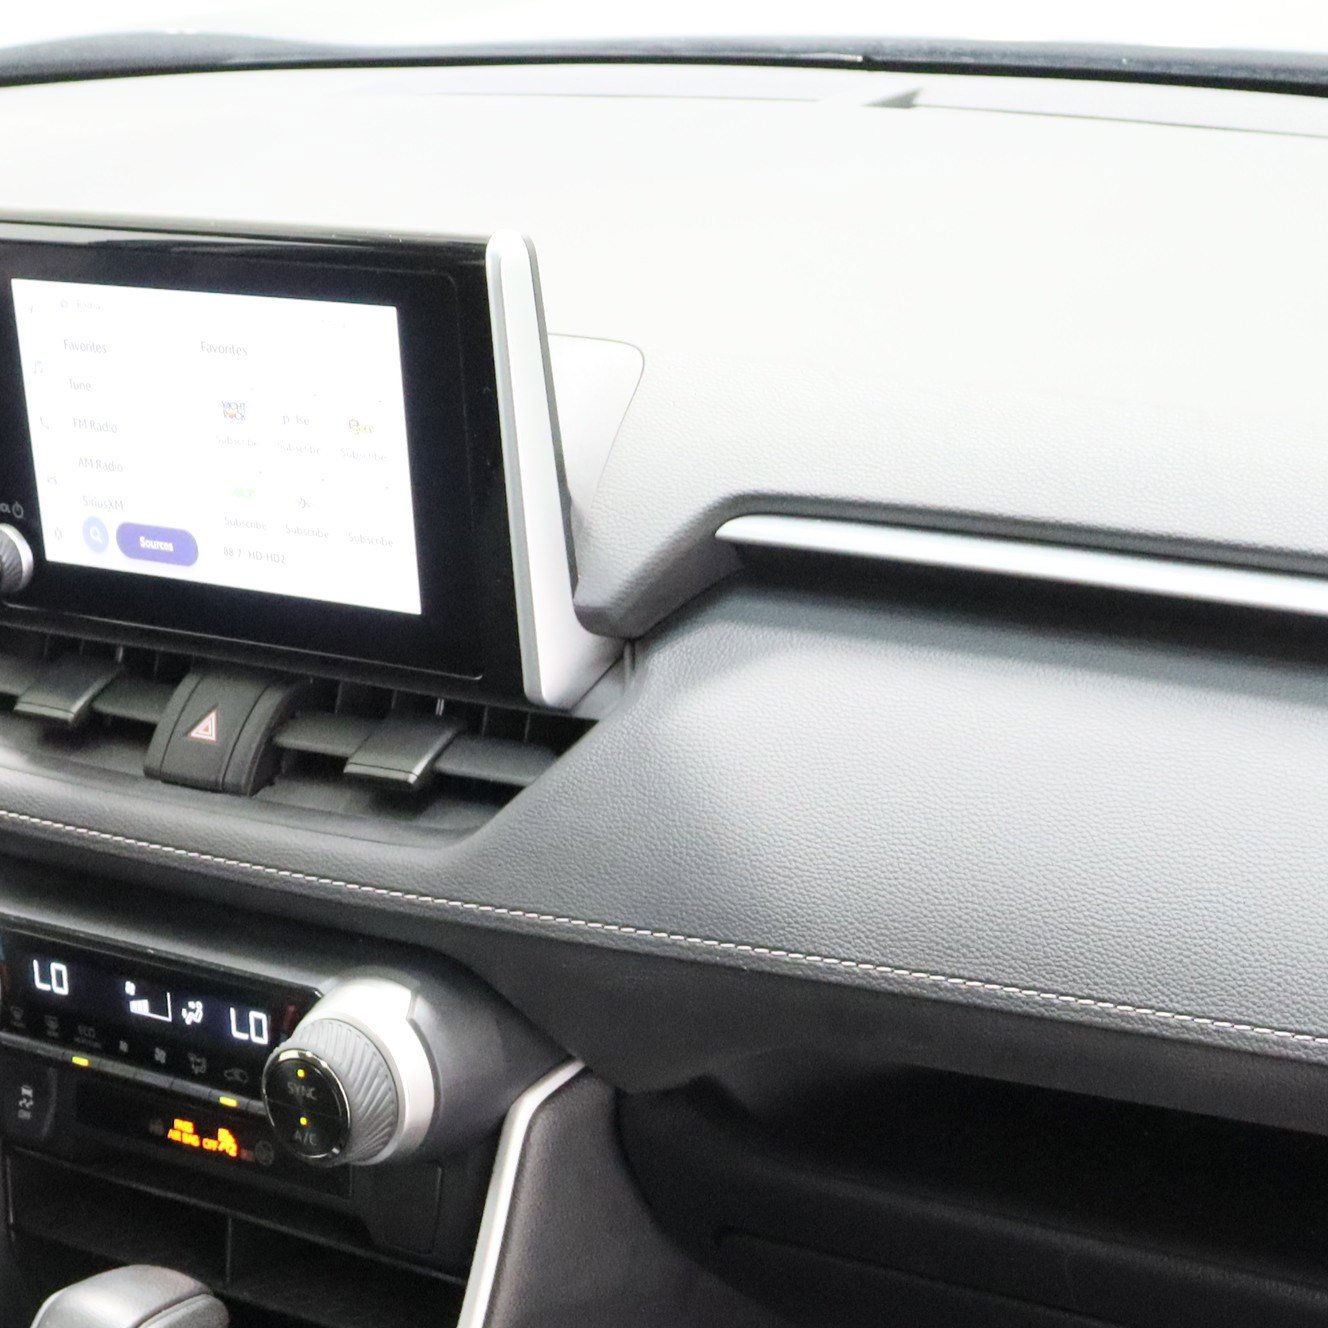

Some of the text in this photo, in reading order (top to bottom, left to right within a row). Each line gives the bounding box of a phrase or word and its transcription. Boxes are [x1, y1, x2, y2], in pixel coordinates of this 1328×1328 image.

[63, 338, 108, 355] Favorites
[200, 339, 248, 357] Favorites
[68, 378, 93, 392] Tune
[72, 417, 119, 434] FM Radio
[78, 457, 124, 473] AM Radio
[82, 495, 125, 511] SiriusXM
[139, 536, 174, 553] Sources
[32, 959, 70, 996] LO
[229, 1006, 270, 1046] LO
[286, 1081, 318, 1101] SYNC
[294, 1129, 318, 1146] A/C
